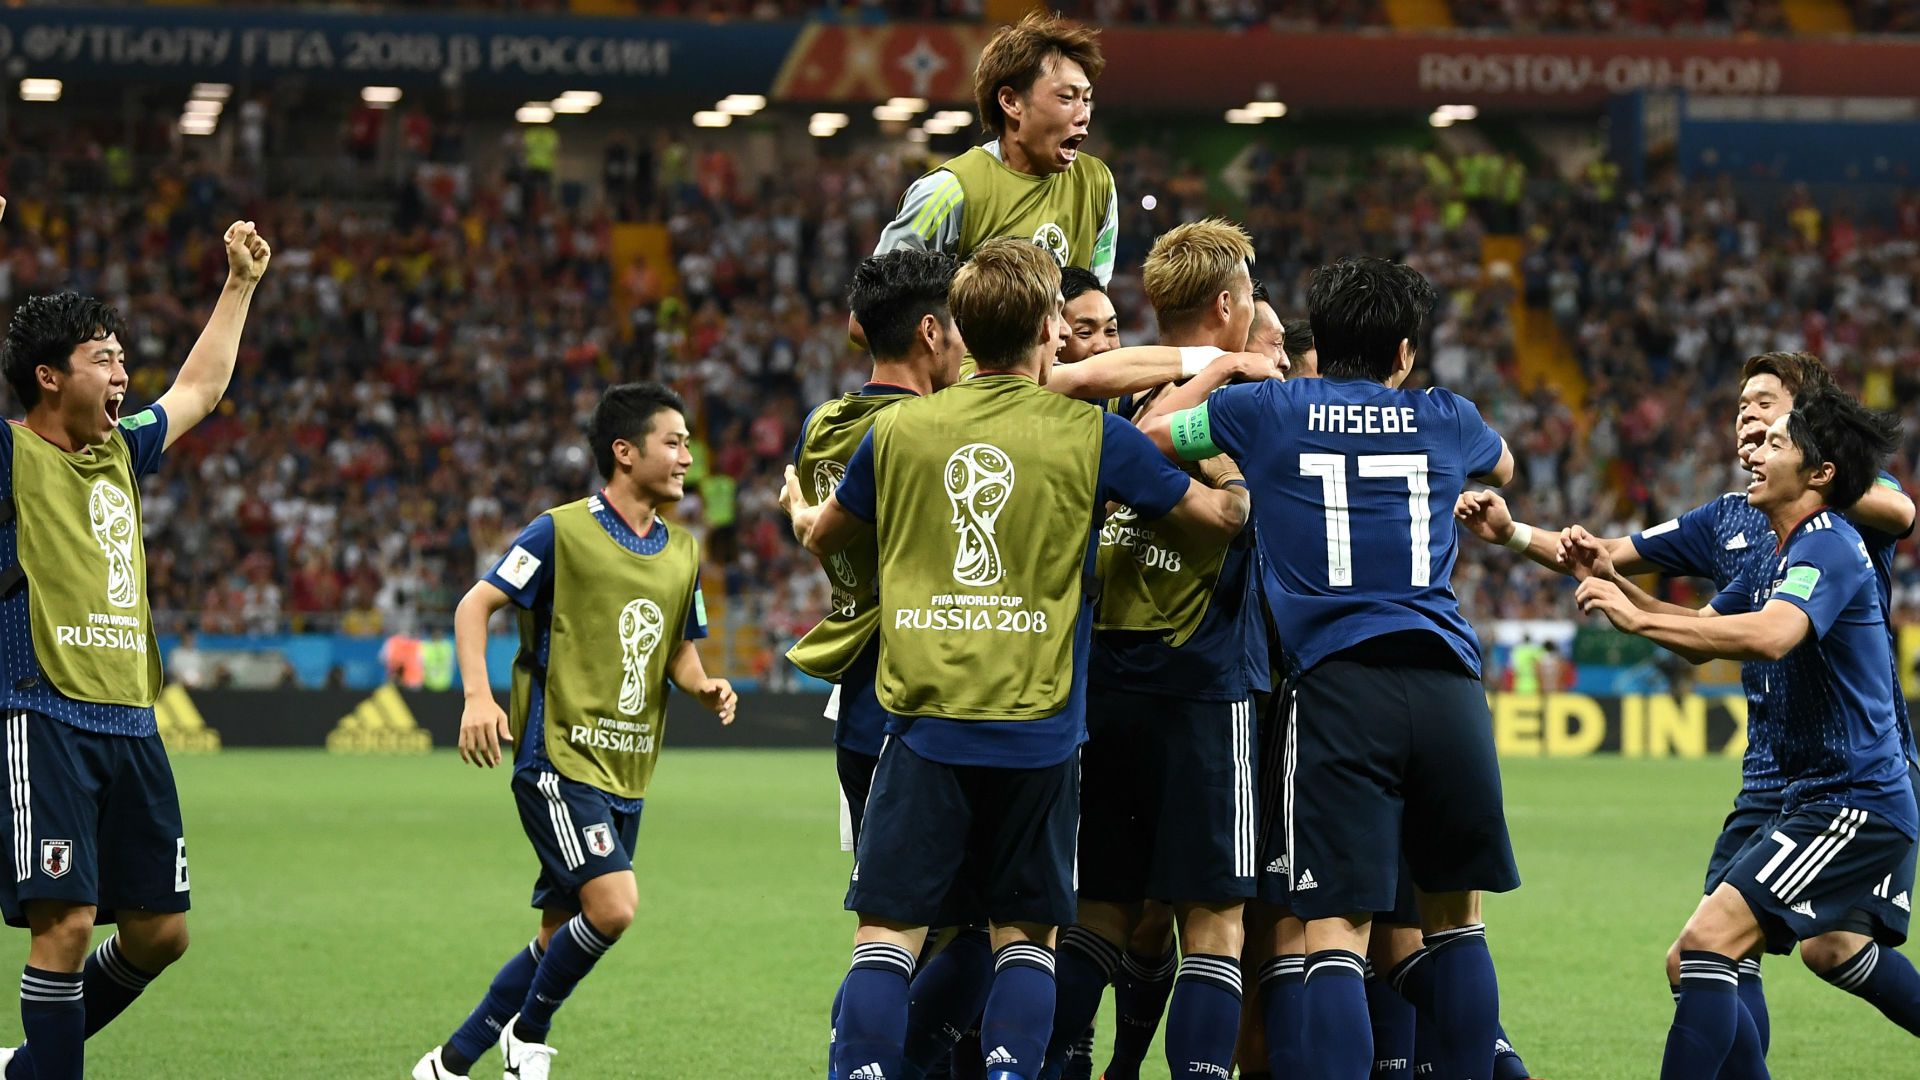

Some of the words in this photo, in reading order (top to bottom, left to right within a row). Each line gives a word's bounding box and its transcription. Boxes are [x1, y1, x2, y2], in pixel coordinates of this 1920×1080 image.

[1308, 403, 1418, 434] HASEBE
[1178, 425, 1187, 446] FIFA
[1299, 453, 1431, 588] 17
[931, 594, 953, 606] FIFA
[954, 595, 998, 606] WORLD
[1000, 595, 1022, 607] CUP
[88, 613, 110, 625] FIFA
[109, 614, 138, 627] WORLD
[894, 608, 993, 631] RUSSIA
[996, 610, 1048, 633] 208
[56, 625, 136, 650] RUSSIA
[598, 717, 616, 729] FIFA
[1488, 693, 1607, 757] ED
[1619, 693, 1708, 757] IN
[570, 725, 634, 752] RUSSIA
[1755, 830, 1798, 884] 7
[1266, 865, 1289, 875] adida
[1189, 1061, 1229, 1080] JAPAN
